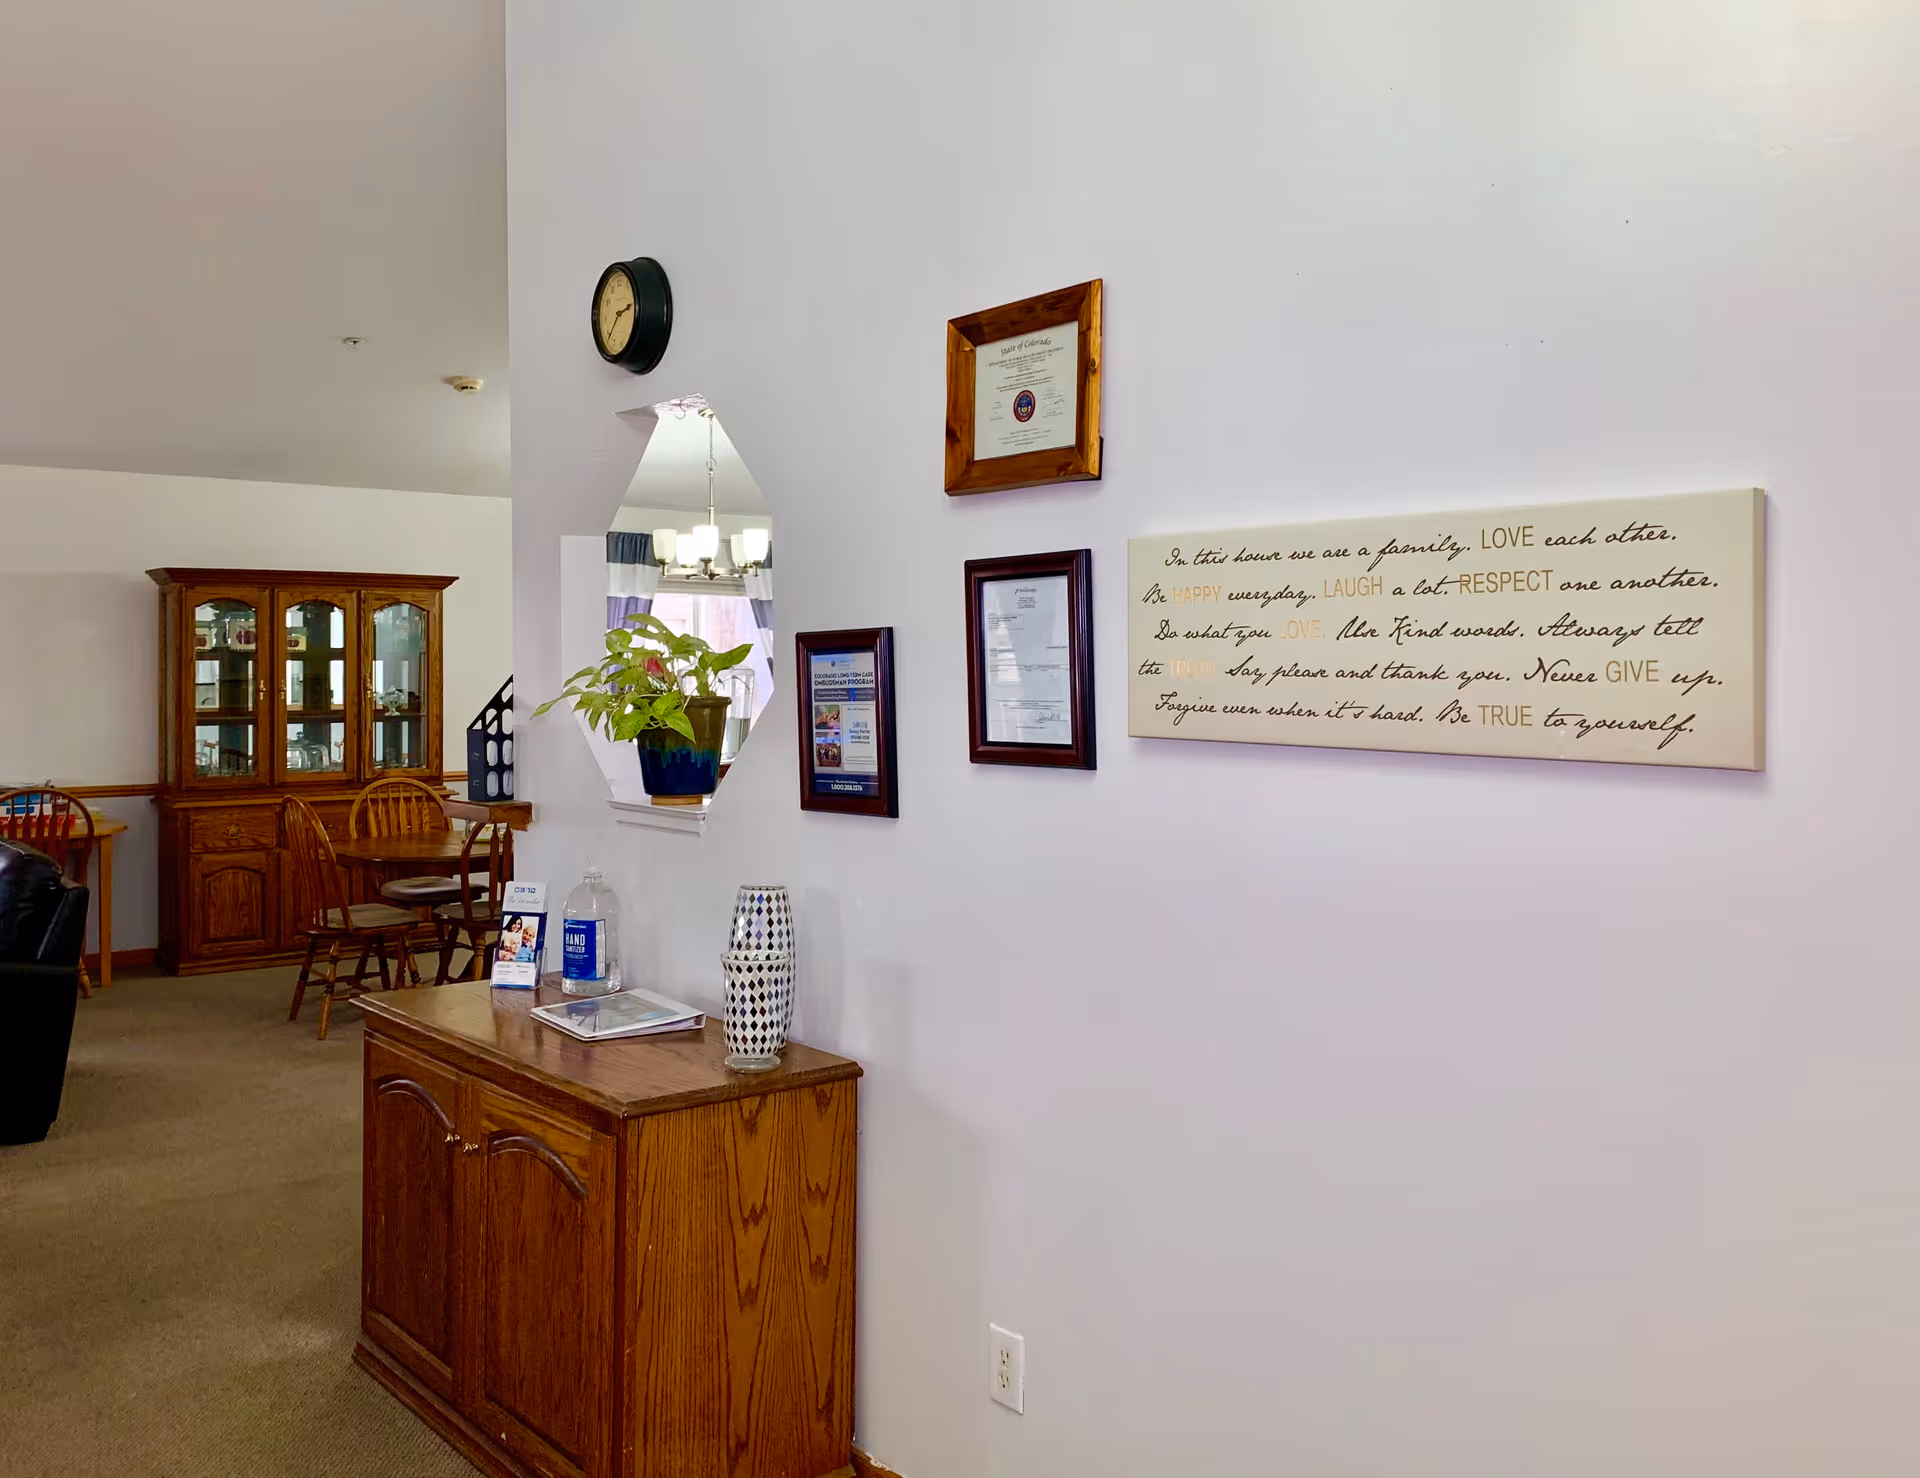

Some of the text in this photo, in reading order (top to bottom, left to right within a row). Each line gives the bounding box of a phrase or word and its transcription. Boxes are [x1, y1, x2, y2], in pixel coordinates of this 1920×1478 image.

[1001, 345, 1016, 356] State
[1024, 337, 1051, 348] Colorado
[1165, 521, 1676, 572] In this house we are a family. LOVE each other.
[1142, 566, 1718, 608] Be HAPPY everyday. LAUGH a lot. RESPECT one another.
[1154, 619, 1179, 639] Do
[1184, 621, 1249, 639] what
[1235, 626, 1272, 647] you
[1336, 615, 1379, 638] Use
[1388, 615, 1447, 645] Kind
[1450, 621, 1525, 637] words.
[1538, 612, 1645, 646] Always
[1653, 614, 1704, 636] tell
[1138, 660, 1164, 677] the
[1225, 655, 1267, 685] Say
[1265, 663, 1329, 686] please
[1336, 662, 1374, 679] and
[1380, 660, 1449, 680] thank
[1457, 670, 1510, 690] you.
[1523, 657, 1598, 683] Never
[1606, 660, 1659, 683] GIVE
[1671, 670, 1723, 696] up.
[1155, 691, 1694, 749] Forgive even when it's hard. Be TRUE to yourself.
[566, 933, 585, 946] HAND
